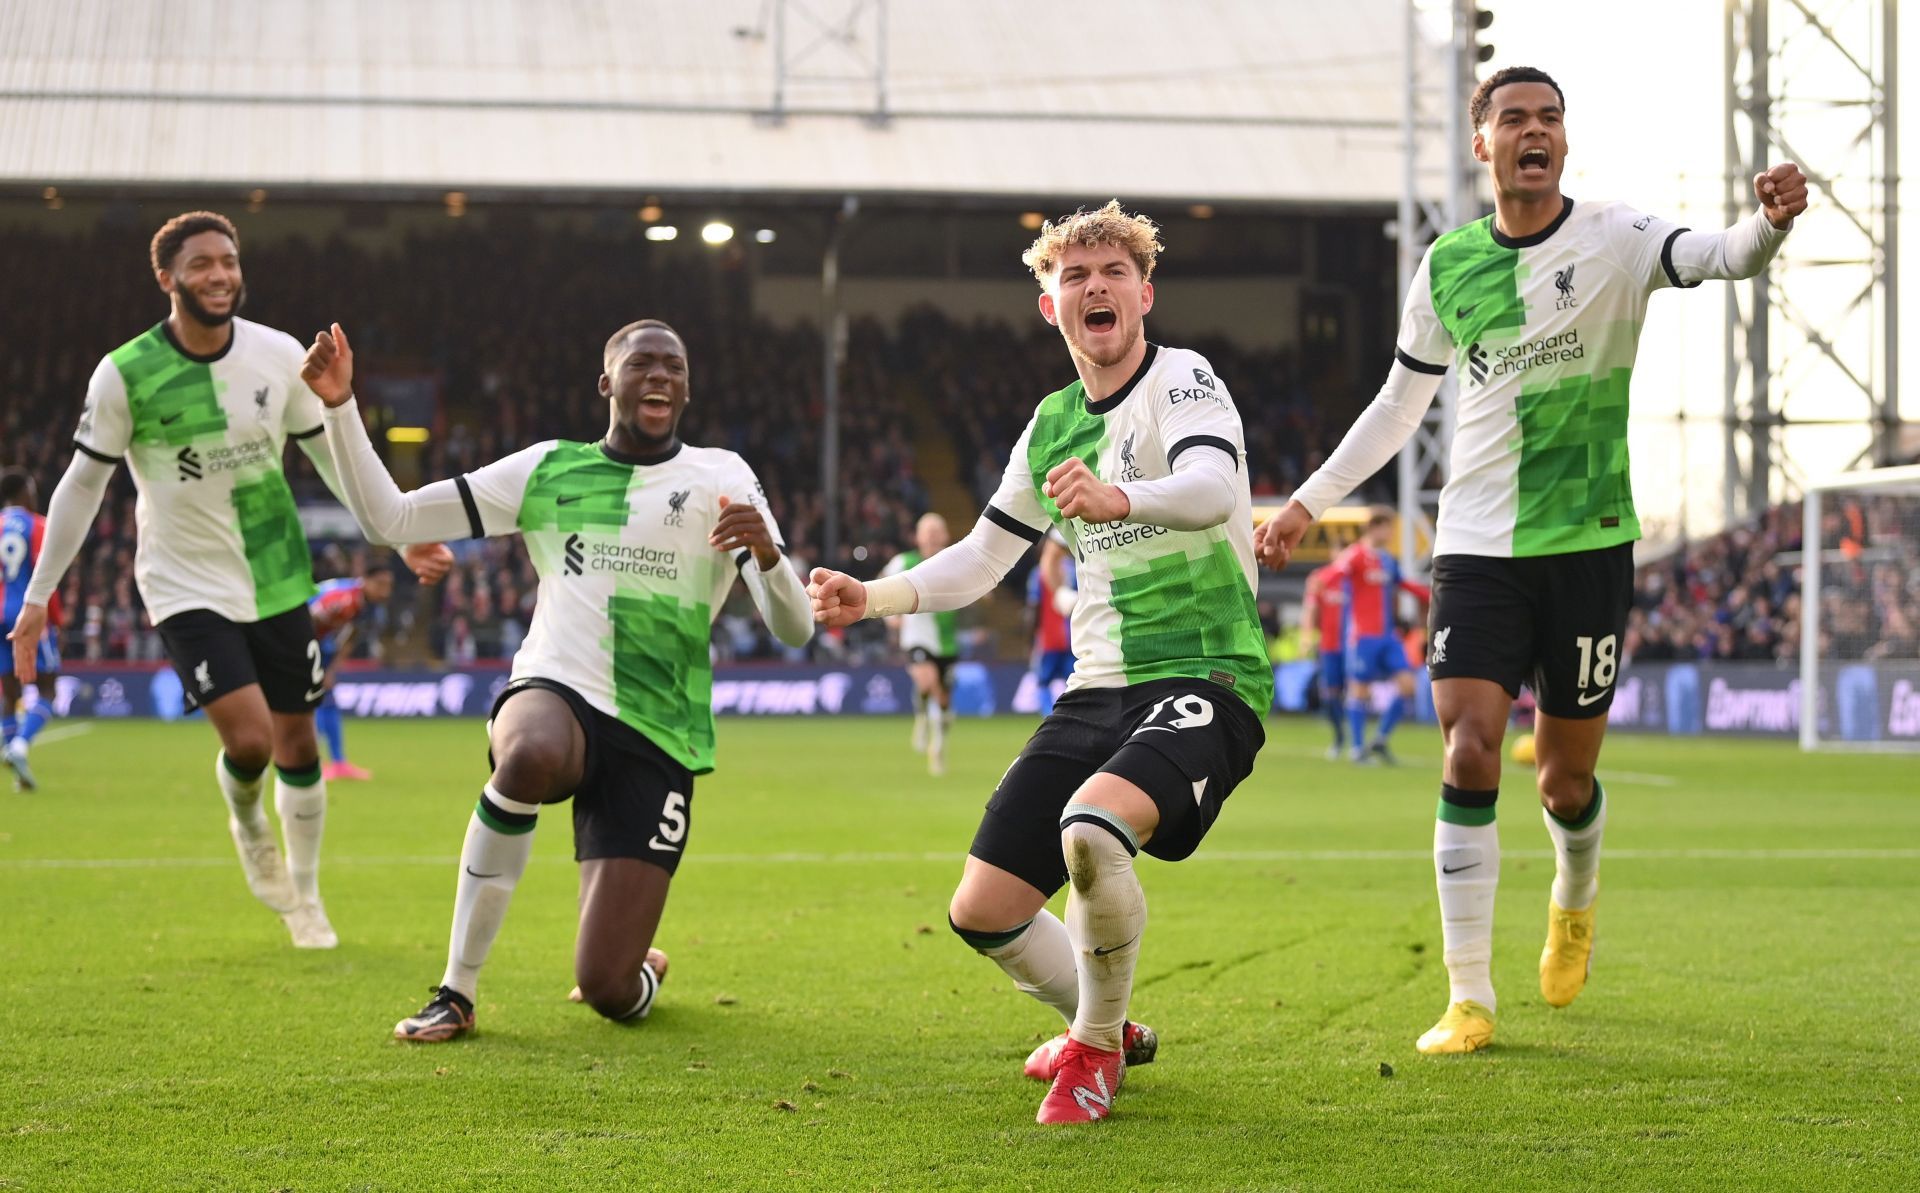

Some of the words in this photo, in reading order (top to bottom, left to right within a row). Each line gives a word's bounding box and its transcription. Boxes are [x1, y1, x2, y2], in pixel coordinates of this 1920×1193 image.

[1494, 344, 1584, 375] chartered
[591, 556, 678, 581] chartered
[592, 541, 676, 565] standard
[307, 639, 325, 685] 2
[1576, 634, 1617, 688] 18
[1139, 694, 1214, 730] 19
[659, 791, 686, 843] 5
